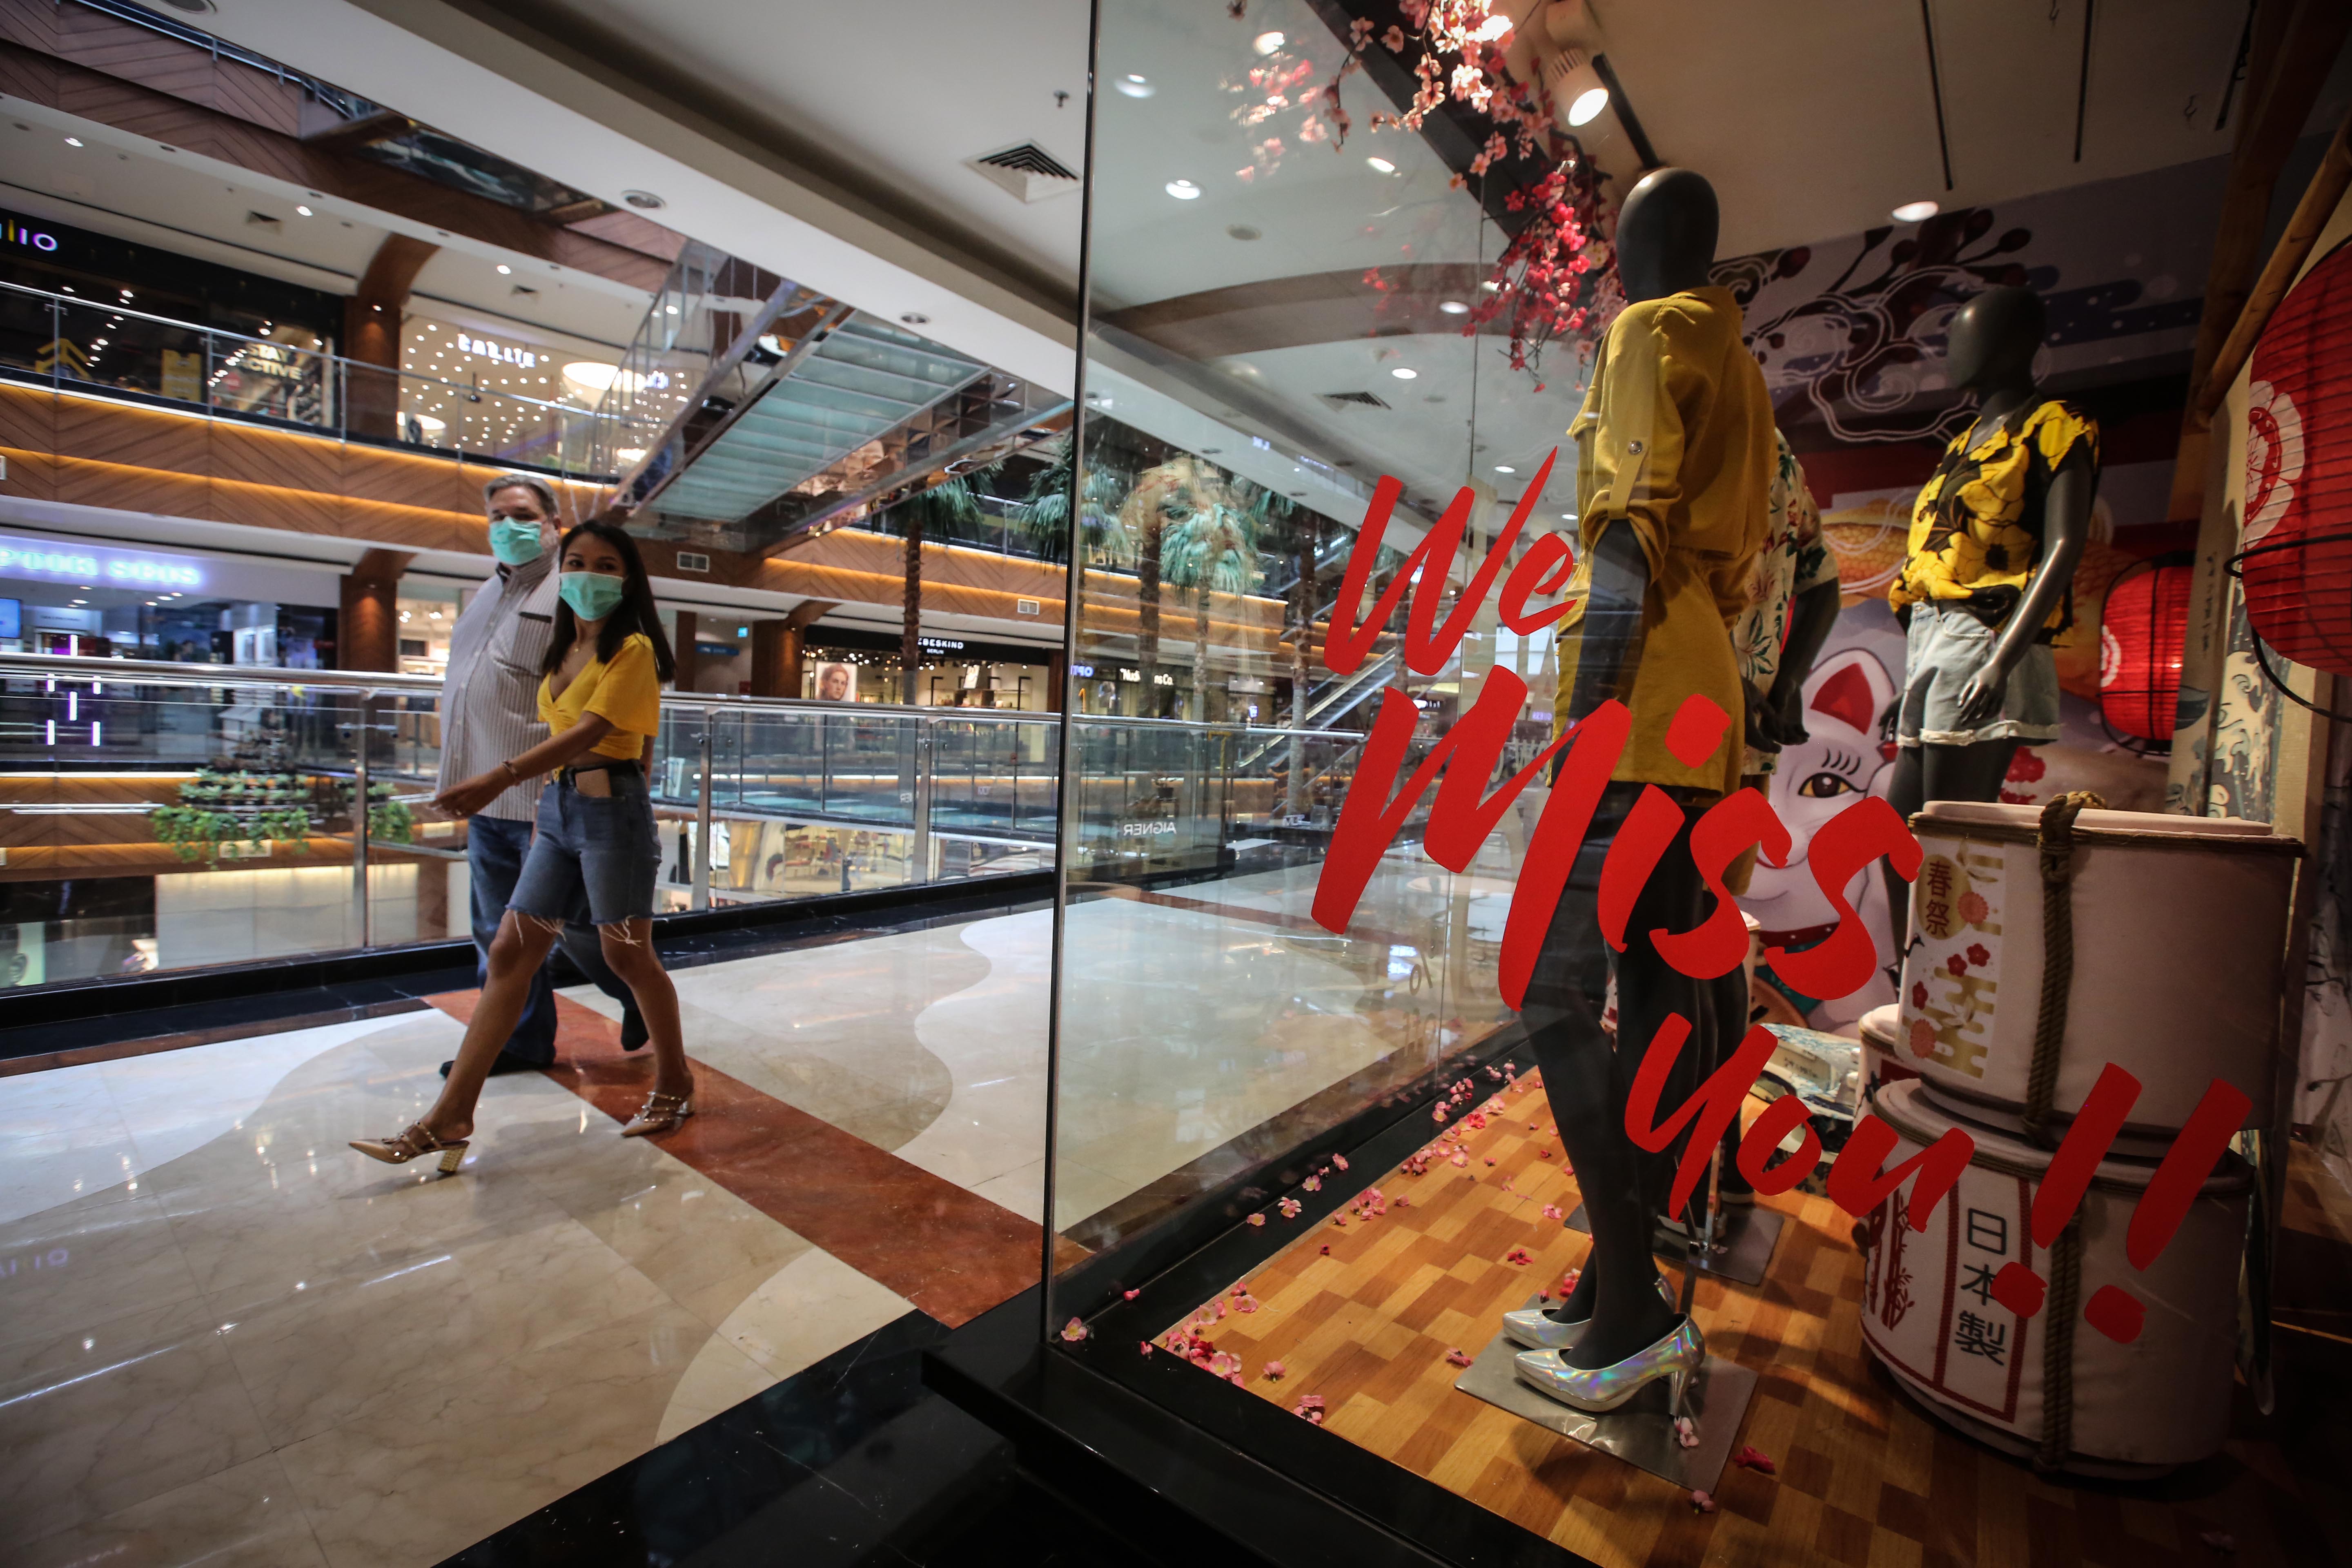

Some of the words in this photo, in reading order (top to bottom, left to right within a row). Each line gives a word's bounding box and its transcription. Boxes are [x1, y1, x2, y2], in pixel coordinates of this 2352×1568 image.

[1323, 445, 1577, 676] We
[1311, 664, 1923, 1011] Miss
[1925, 860, 1952, 937] 春祭
[1954, 1207, 2007, 1366] 日本製
